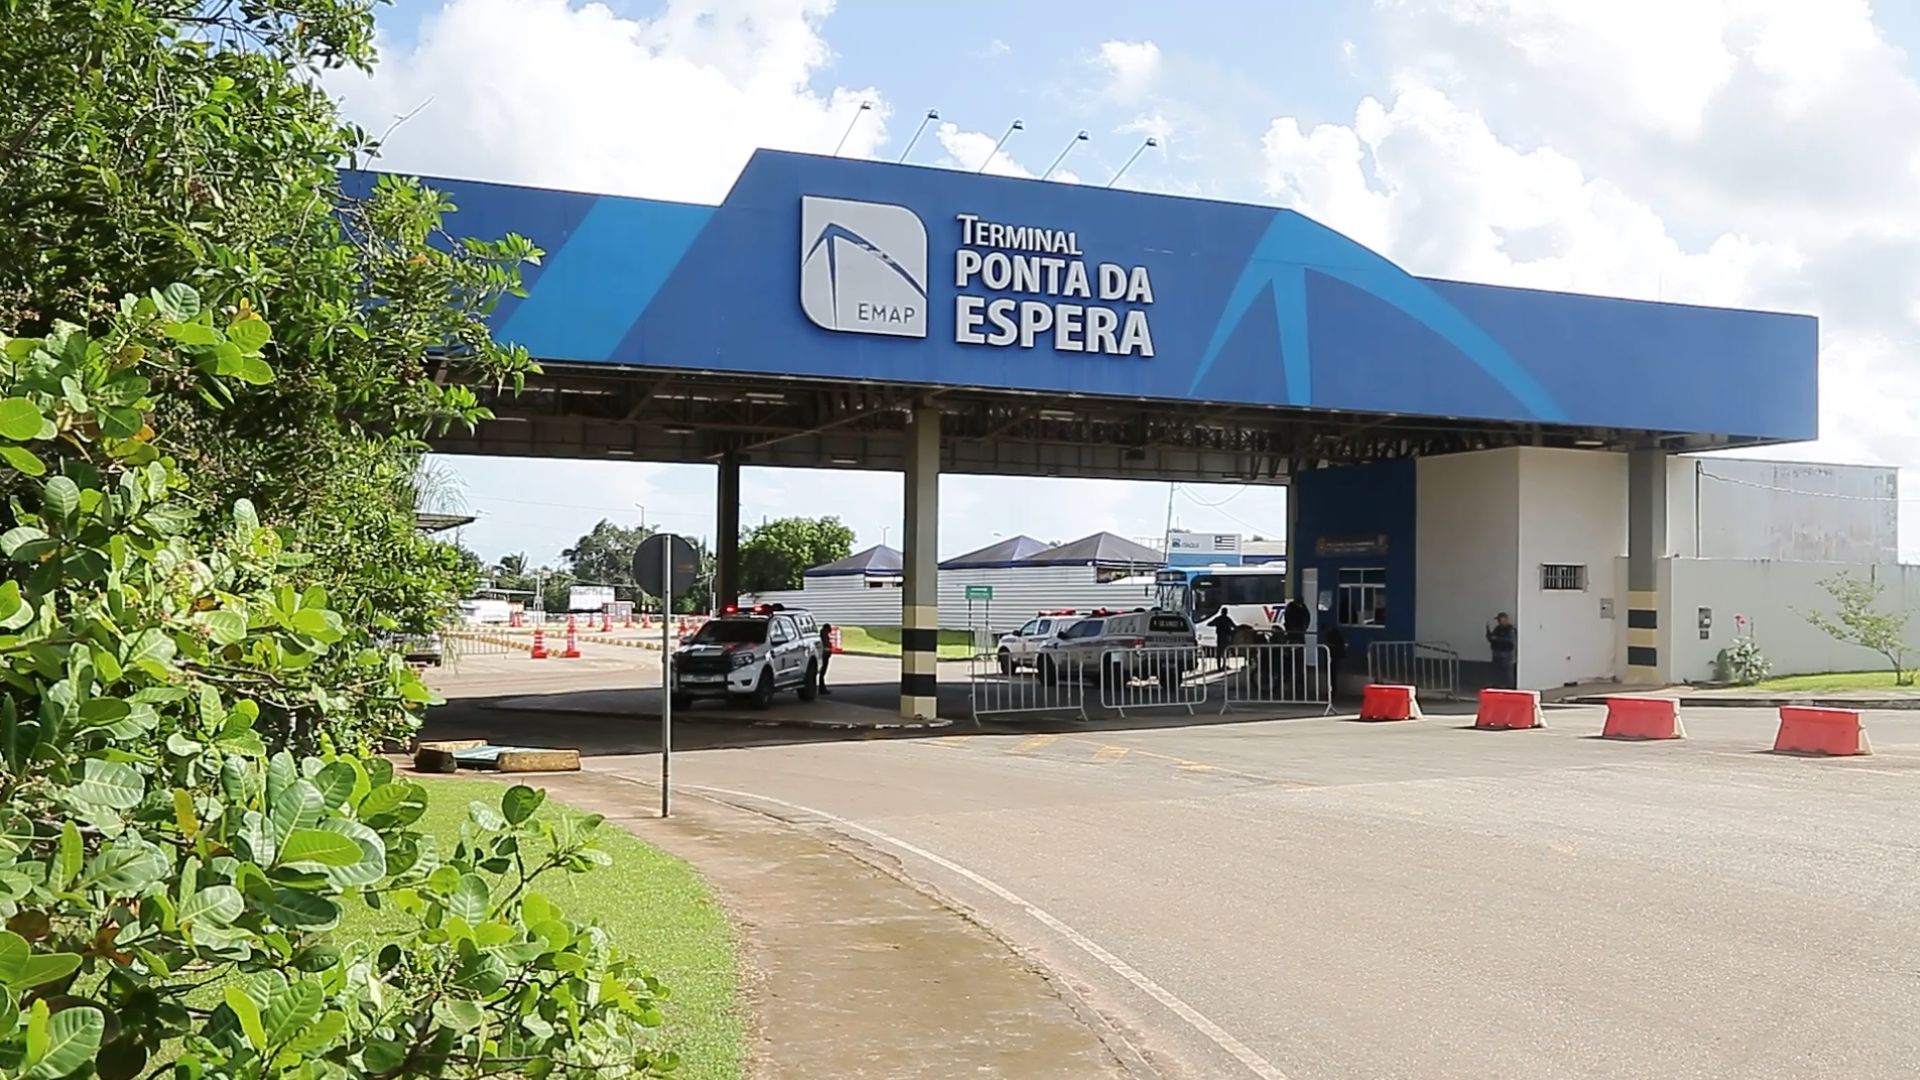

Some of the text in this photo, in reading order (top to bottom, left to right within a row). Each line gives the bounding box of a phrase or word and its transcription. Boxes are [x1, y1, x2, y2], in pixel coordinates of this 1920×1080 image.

[956, 213, 1083, 256] TERMINAL
[955, 249, 1154, 304] PONTA DA
[858, 302, 916, 324] EMAP
[955, 294, 1155, 357] ESPERA
